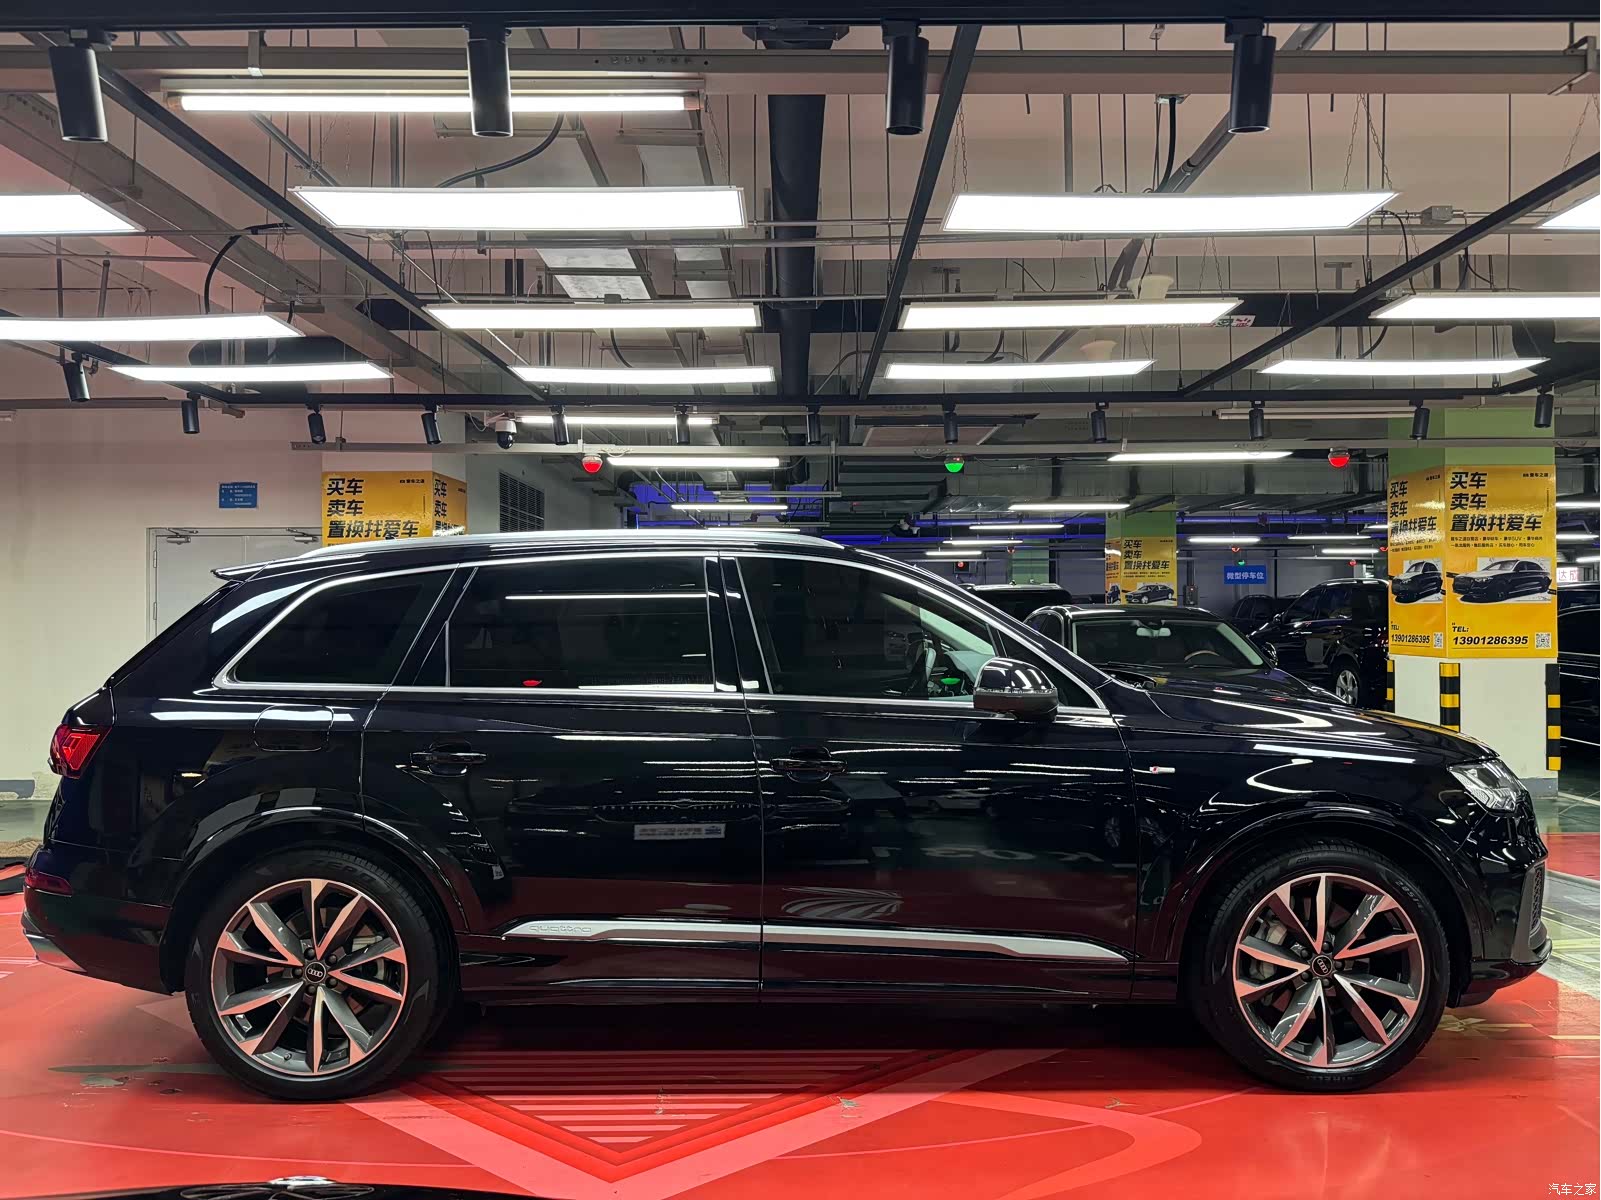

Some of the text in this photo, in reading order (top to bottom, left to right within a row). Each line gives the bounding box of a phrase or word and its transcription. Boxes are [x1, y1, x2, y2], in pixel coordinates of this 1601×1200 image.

[327, 478, 364, 496] 买车
[434, 479, 447, 498] 买车
[1390, 480, 1408, 499] 买车
[1450, 472, 1487, 489] 买车
[327, 499, 364, 517] 卖车
[434, 500, 447, 518] 卖车
[1390, 500, 1408, 518] 卖车
[1450, 493, 1487, 510] 卖车
[327, 520, 419, 540] 置换找爱车
[1450, 514, 1543, 532] 置换找爱车
[1124, 540, 1142, 549] 买车
[1124, 550, 1142, 560] 卖车
[1391, 633, 1430, 644] 13901286395
[1452, 636, 1529, 645] 13901286395
[529, 925, 592, 933] quattro
